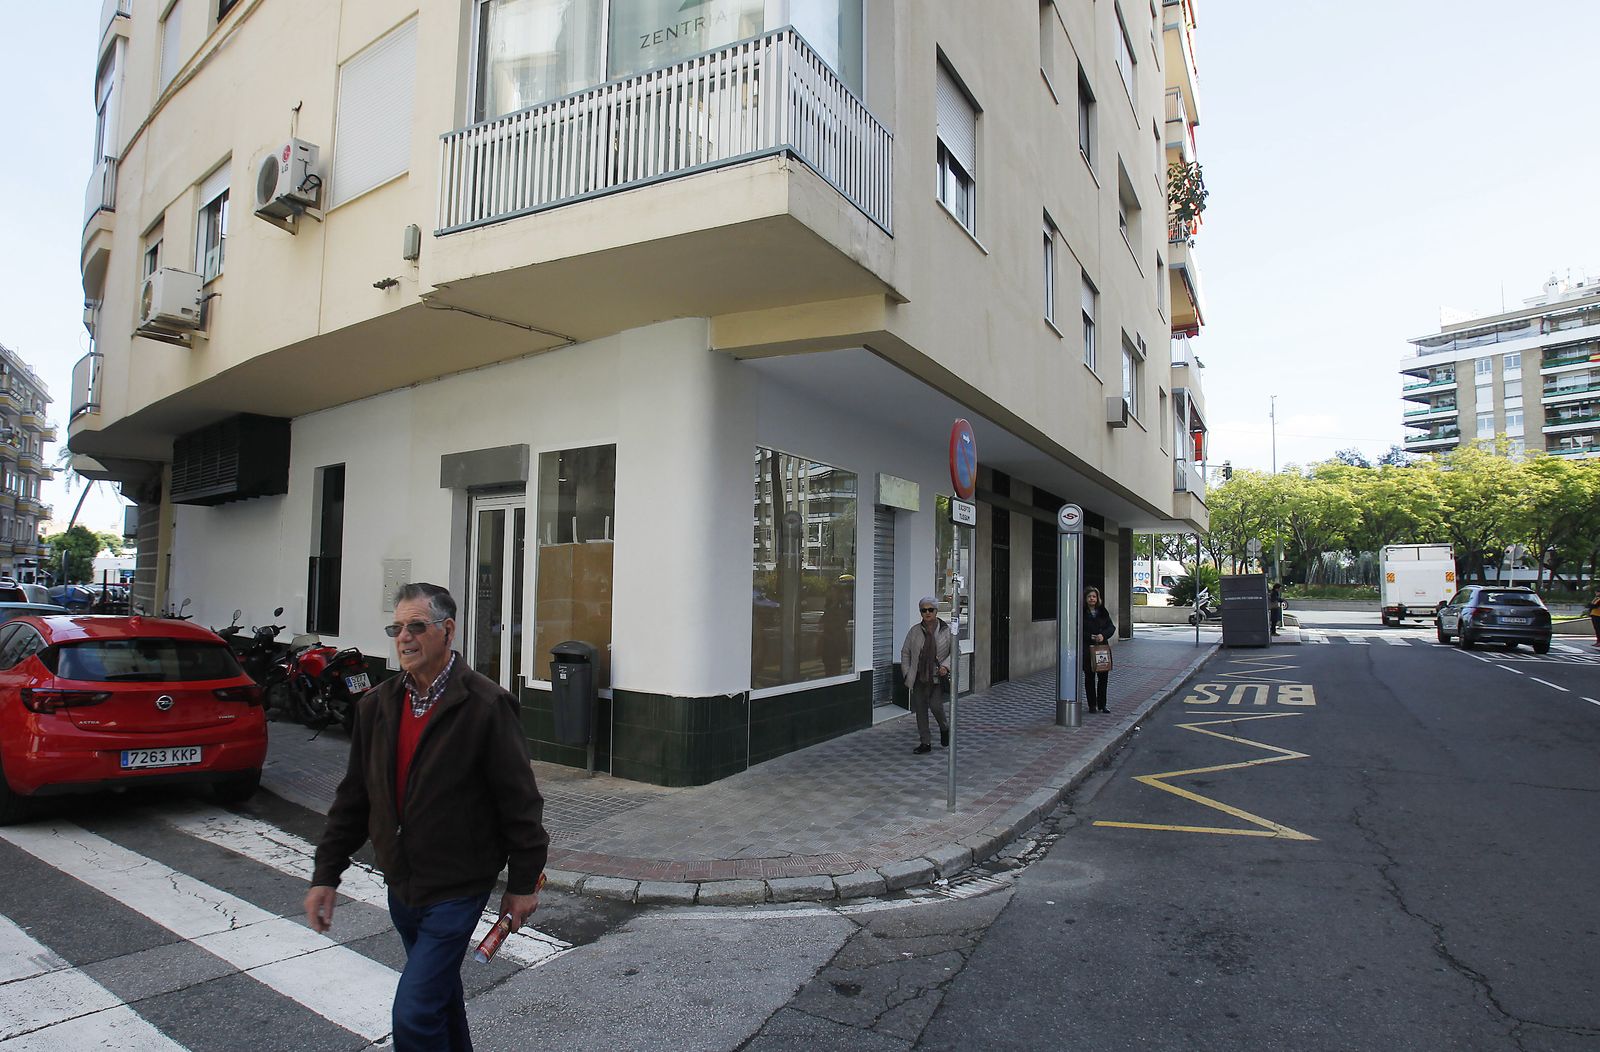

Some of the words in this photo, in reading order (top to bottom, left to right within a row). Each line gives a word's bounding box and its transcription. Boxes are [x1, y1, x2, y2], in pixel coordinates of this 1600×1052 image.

[1183, 683, 1317, 706] BUS
[130, 750, 167, 765] 7263
[171, 748, 198, 762] KKP
